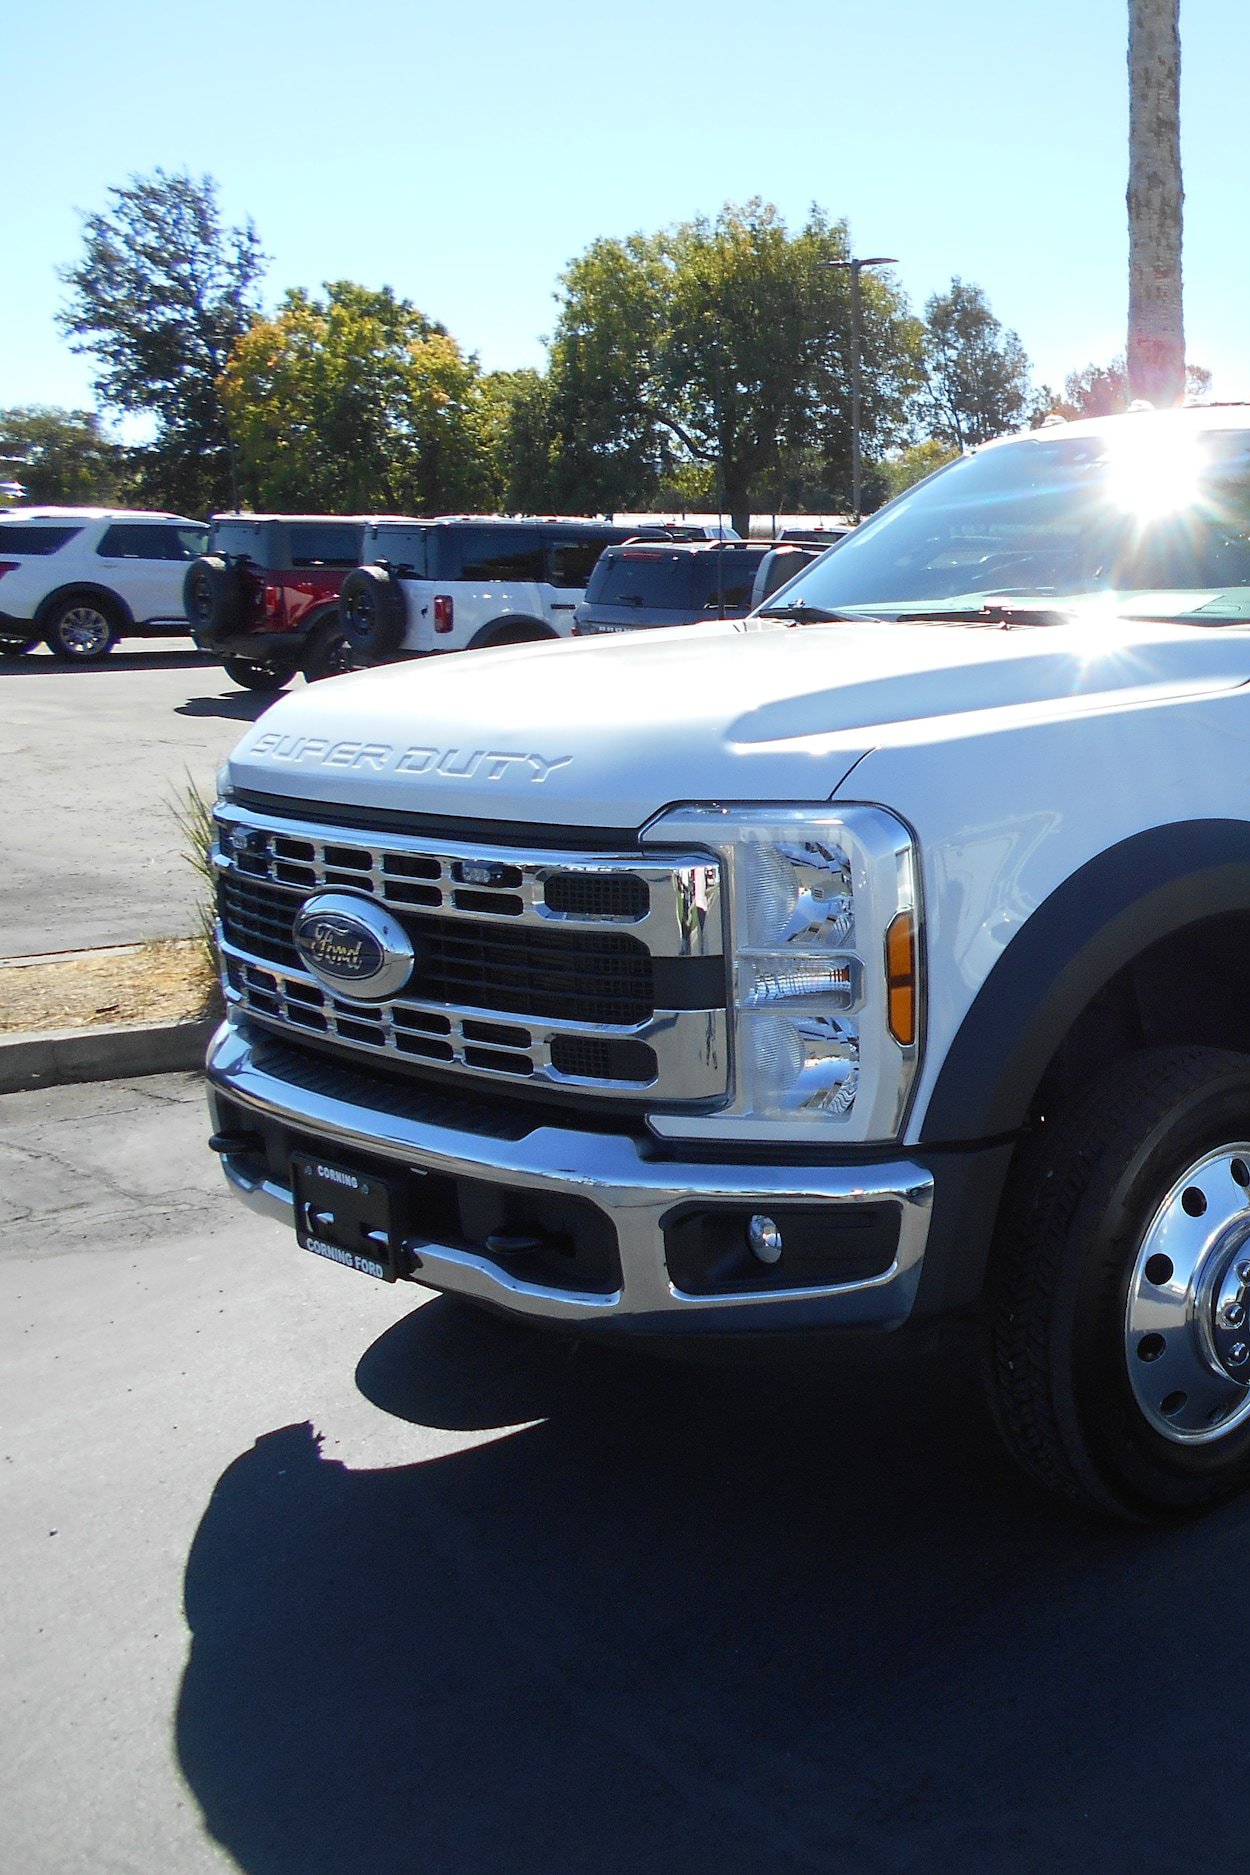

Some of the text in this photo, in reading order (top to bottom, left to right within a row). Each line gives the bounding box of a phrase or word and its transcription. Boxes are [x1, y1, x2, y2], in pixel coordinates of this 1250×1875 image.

[250, 733, 575, 783] SUPER DUTY
[311, 922, 363, 970] Ford
[317, 1165, 358, 1188] CORNING
[307, 1238, 384, 1278] CORNING FORD
